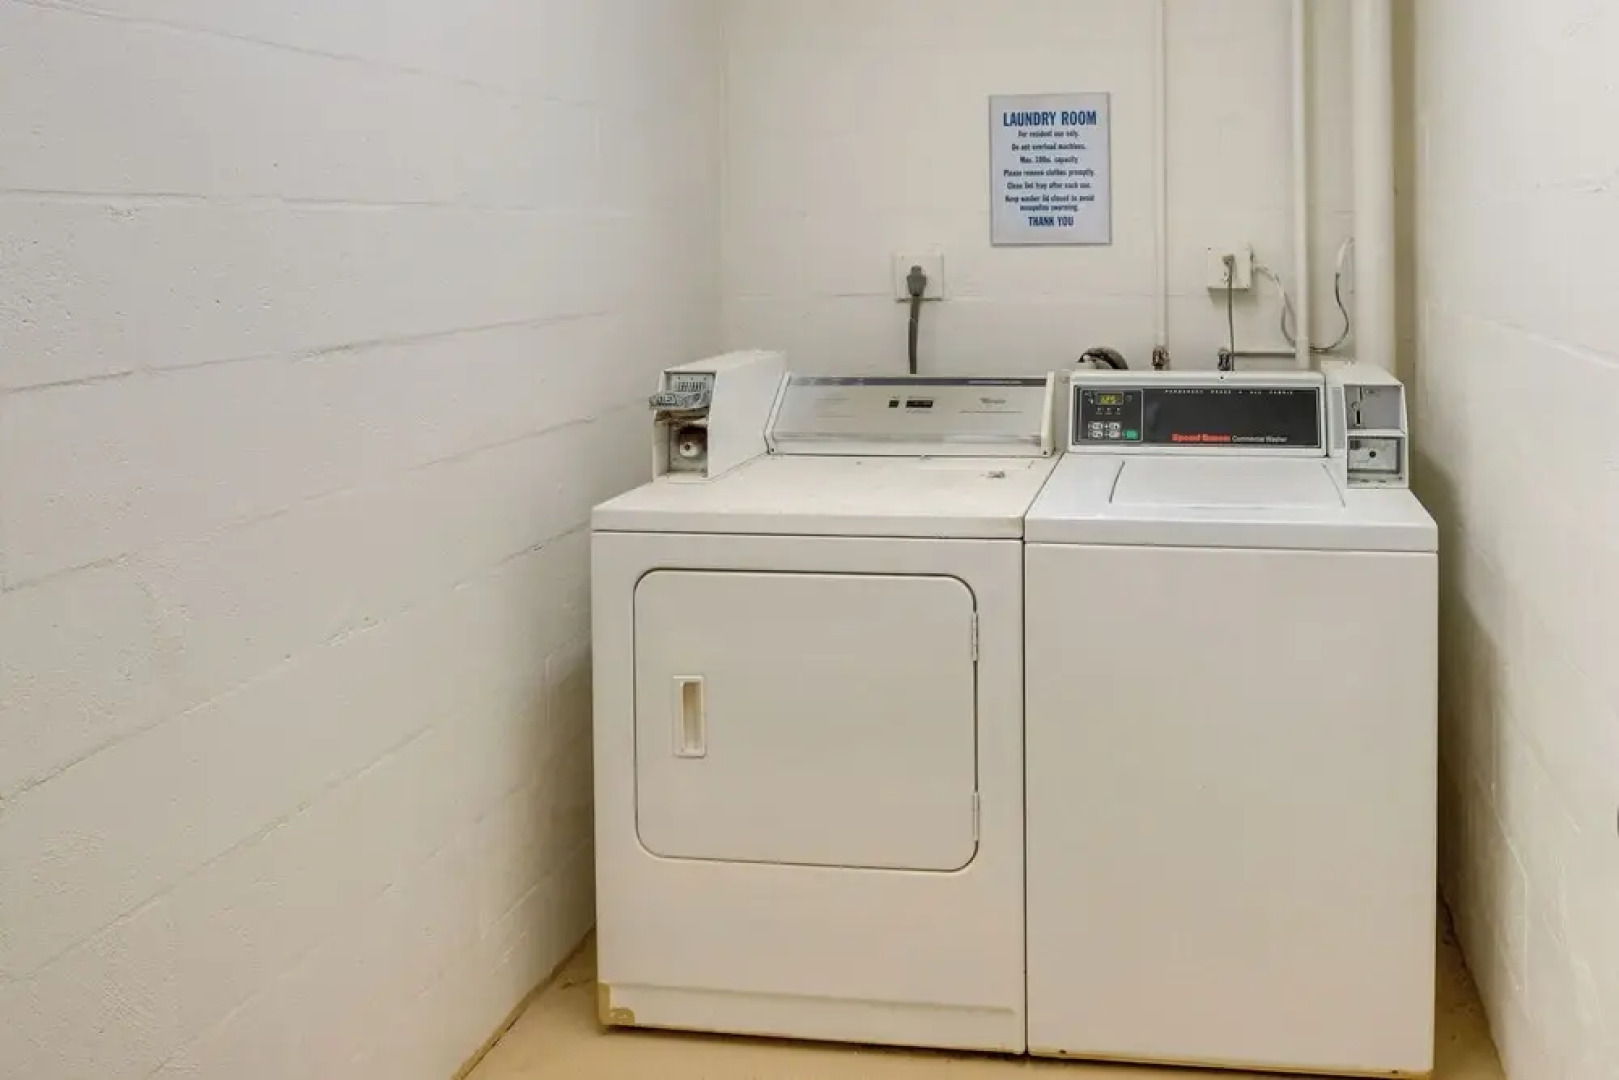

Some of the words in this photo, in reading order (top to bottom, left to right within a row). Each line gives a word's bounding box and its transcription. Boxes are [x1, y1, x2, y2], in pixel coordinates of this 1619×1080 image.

[1003, 111, 1056, 127] LAUNDRY
[1061, 110, 1097, 125] ROOM
[1029, 130, 1053, 138] resident
[1003, 169, 1022, 177] Please
[1028, 216, 1055, 227] THANK
[1057, 216, 1074, 227] YOU
[1172, 433, 1201, 443] Speed
